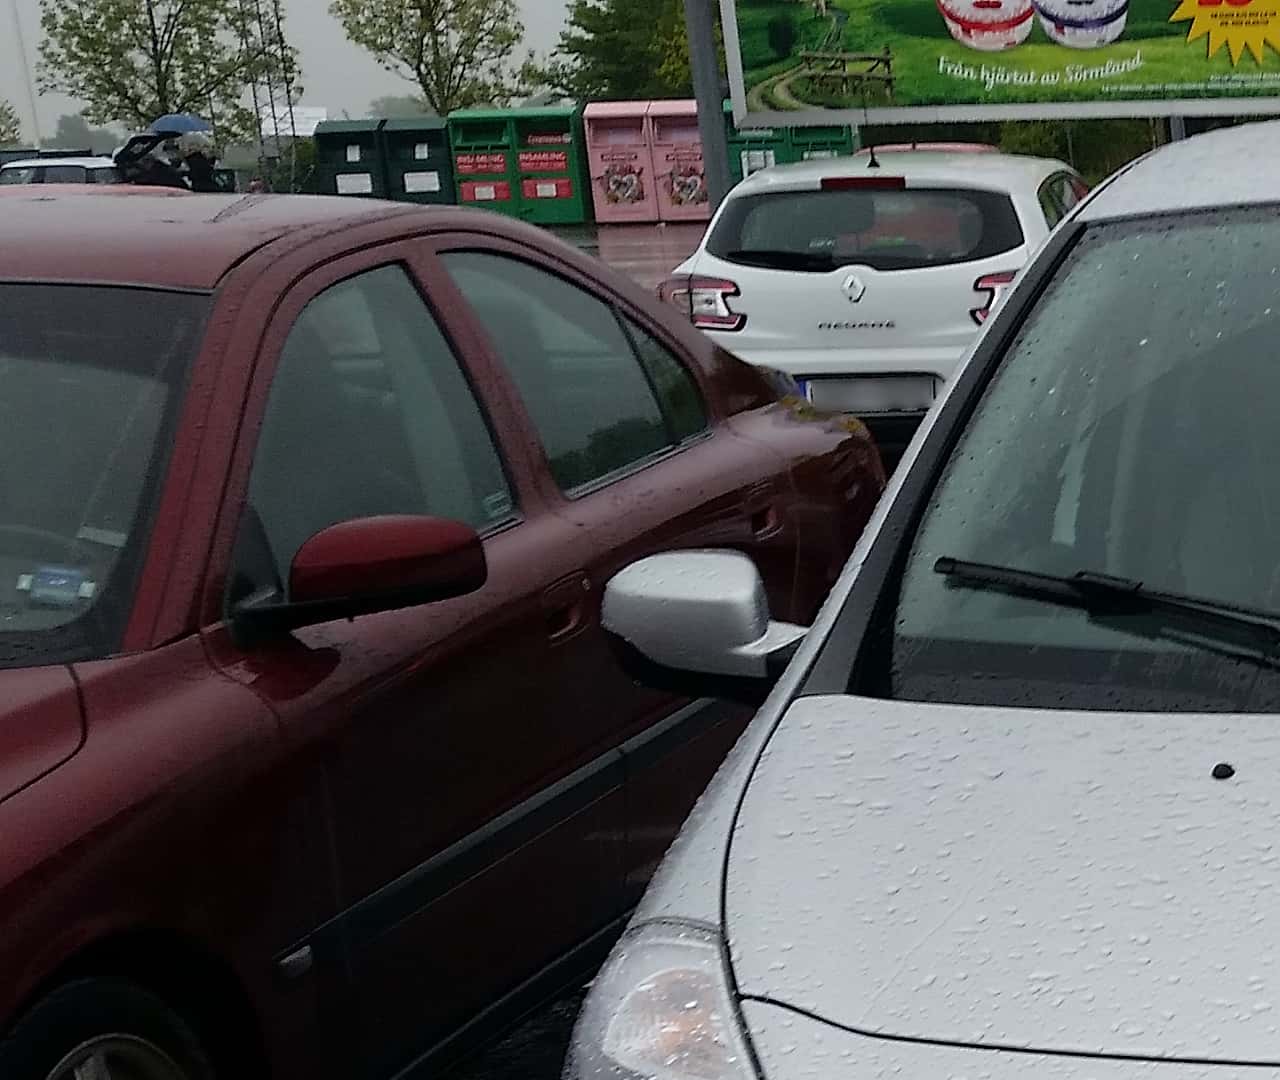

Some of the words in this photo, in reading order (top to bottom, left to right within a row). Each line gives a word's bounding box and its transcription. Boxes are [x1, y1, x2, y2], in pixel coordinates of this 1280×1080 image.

[938, 55, 976, 81] Från
[980, 63, 1037, 91] hjärtat
[1040, 71, 1060, 86] av
[1064, 50, 1144, 84] Sörmland
